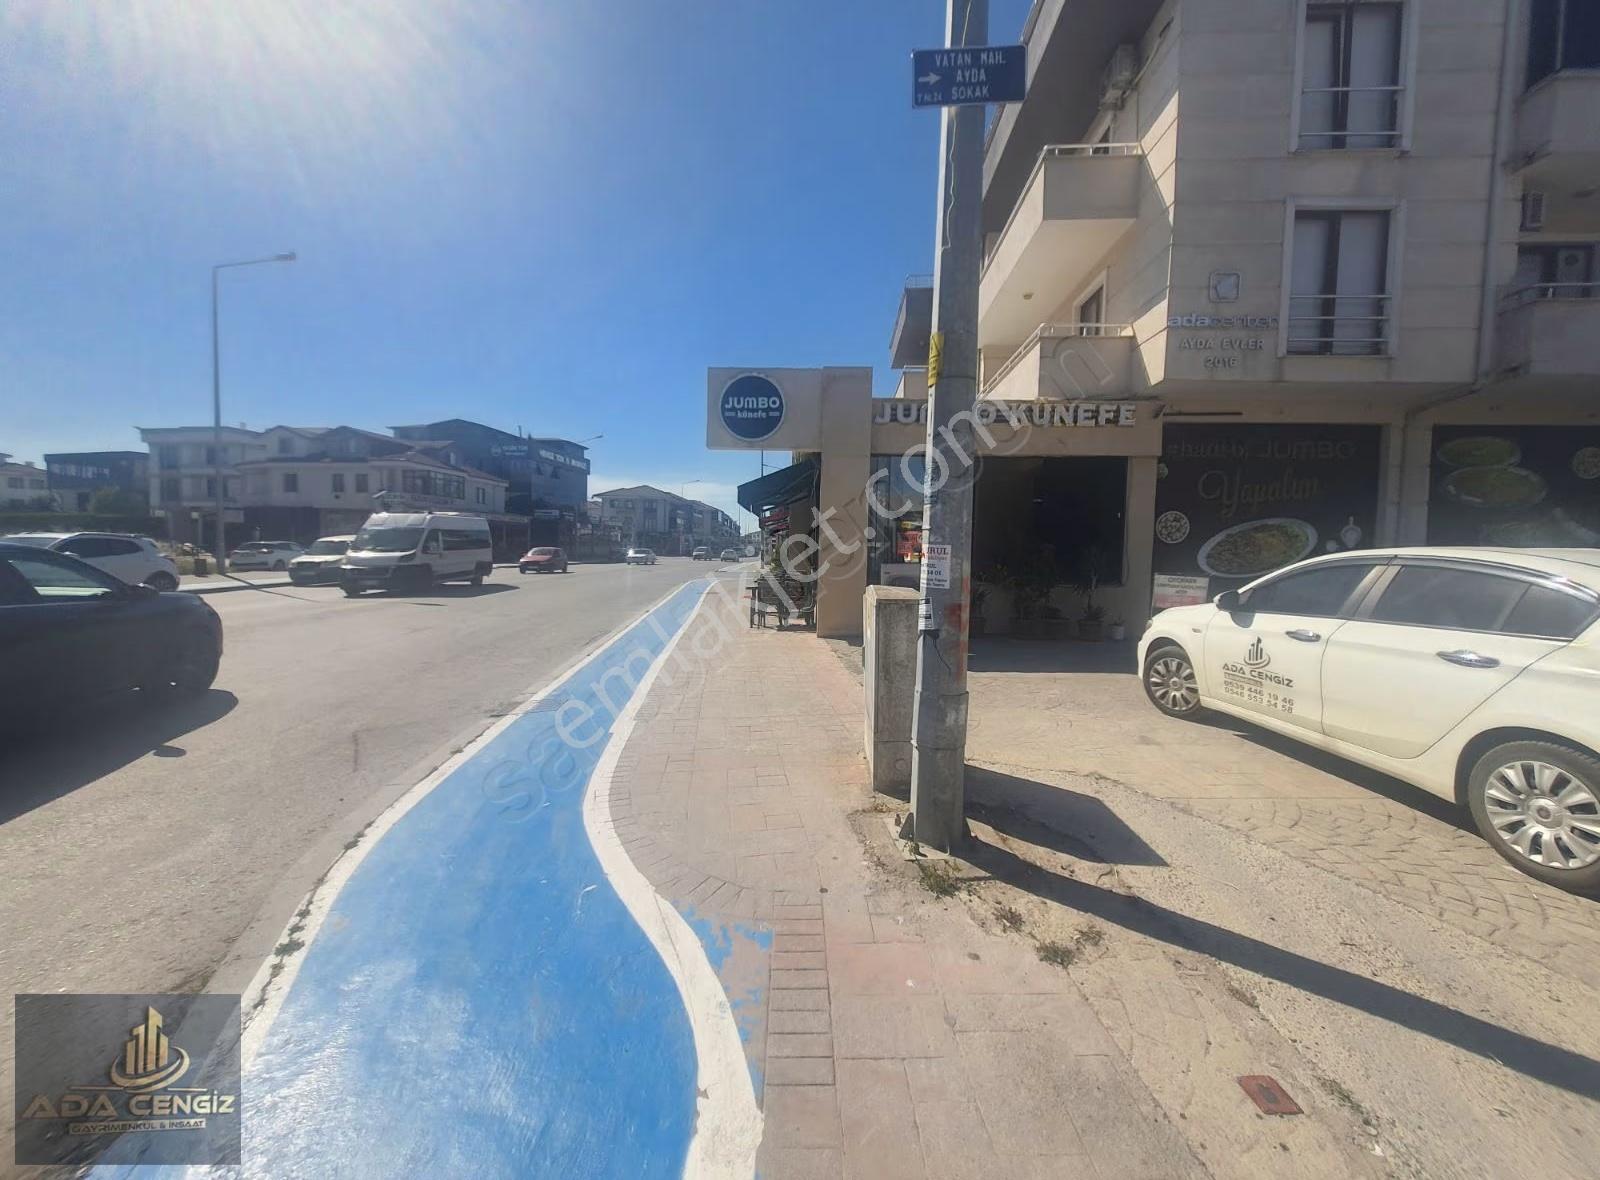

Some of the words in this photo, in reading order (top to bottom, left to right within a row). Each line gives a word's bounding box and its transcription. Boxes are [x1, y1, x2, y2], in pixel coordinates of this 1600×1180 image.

[935, 53, 972, 67] VATAN
[980, 50, 1007, 65] MAH.
[956, 69, 986, 82] AYDA
[951, 86, 990, 100] SOKAK
[1181, 338, 1214, 350] AYDA
[725, 396, 781, 409] JUMBO
[737, 409, 768, 419] künefe
[874, 401, 998, 425] JUO
[1222, 662, 1246, 676] ADA
